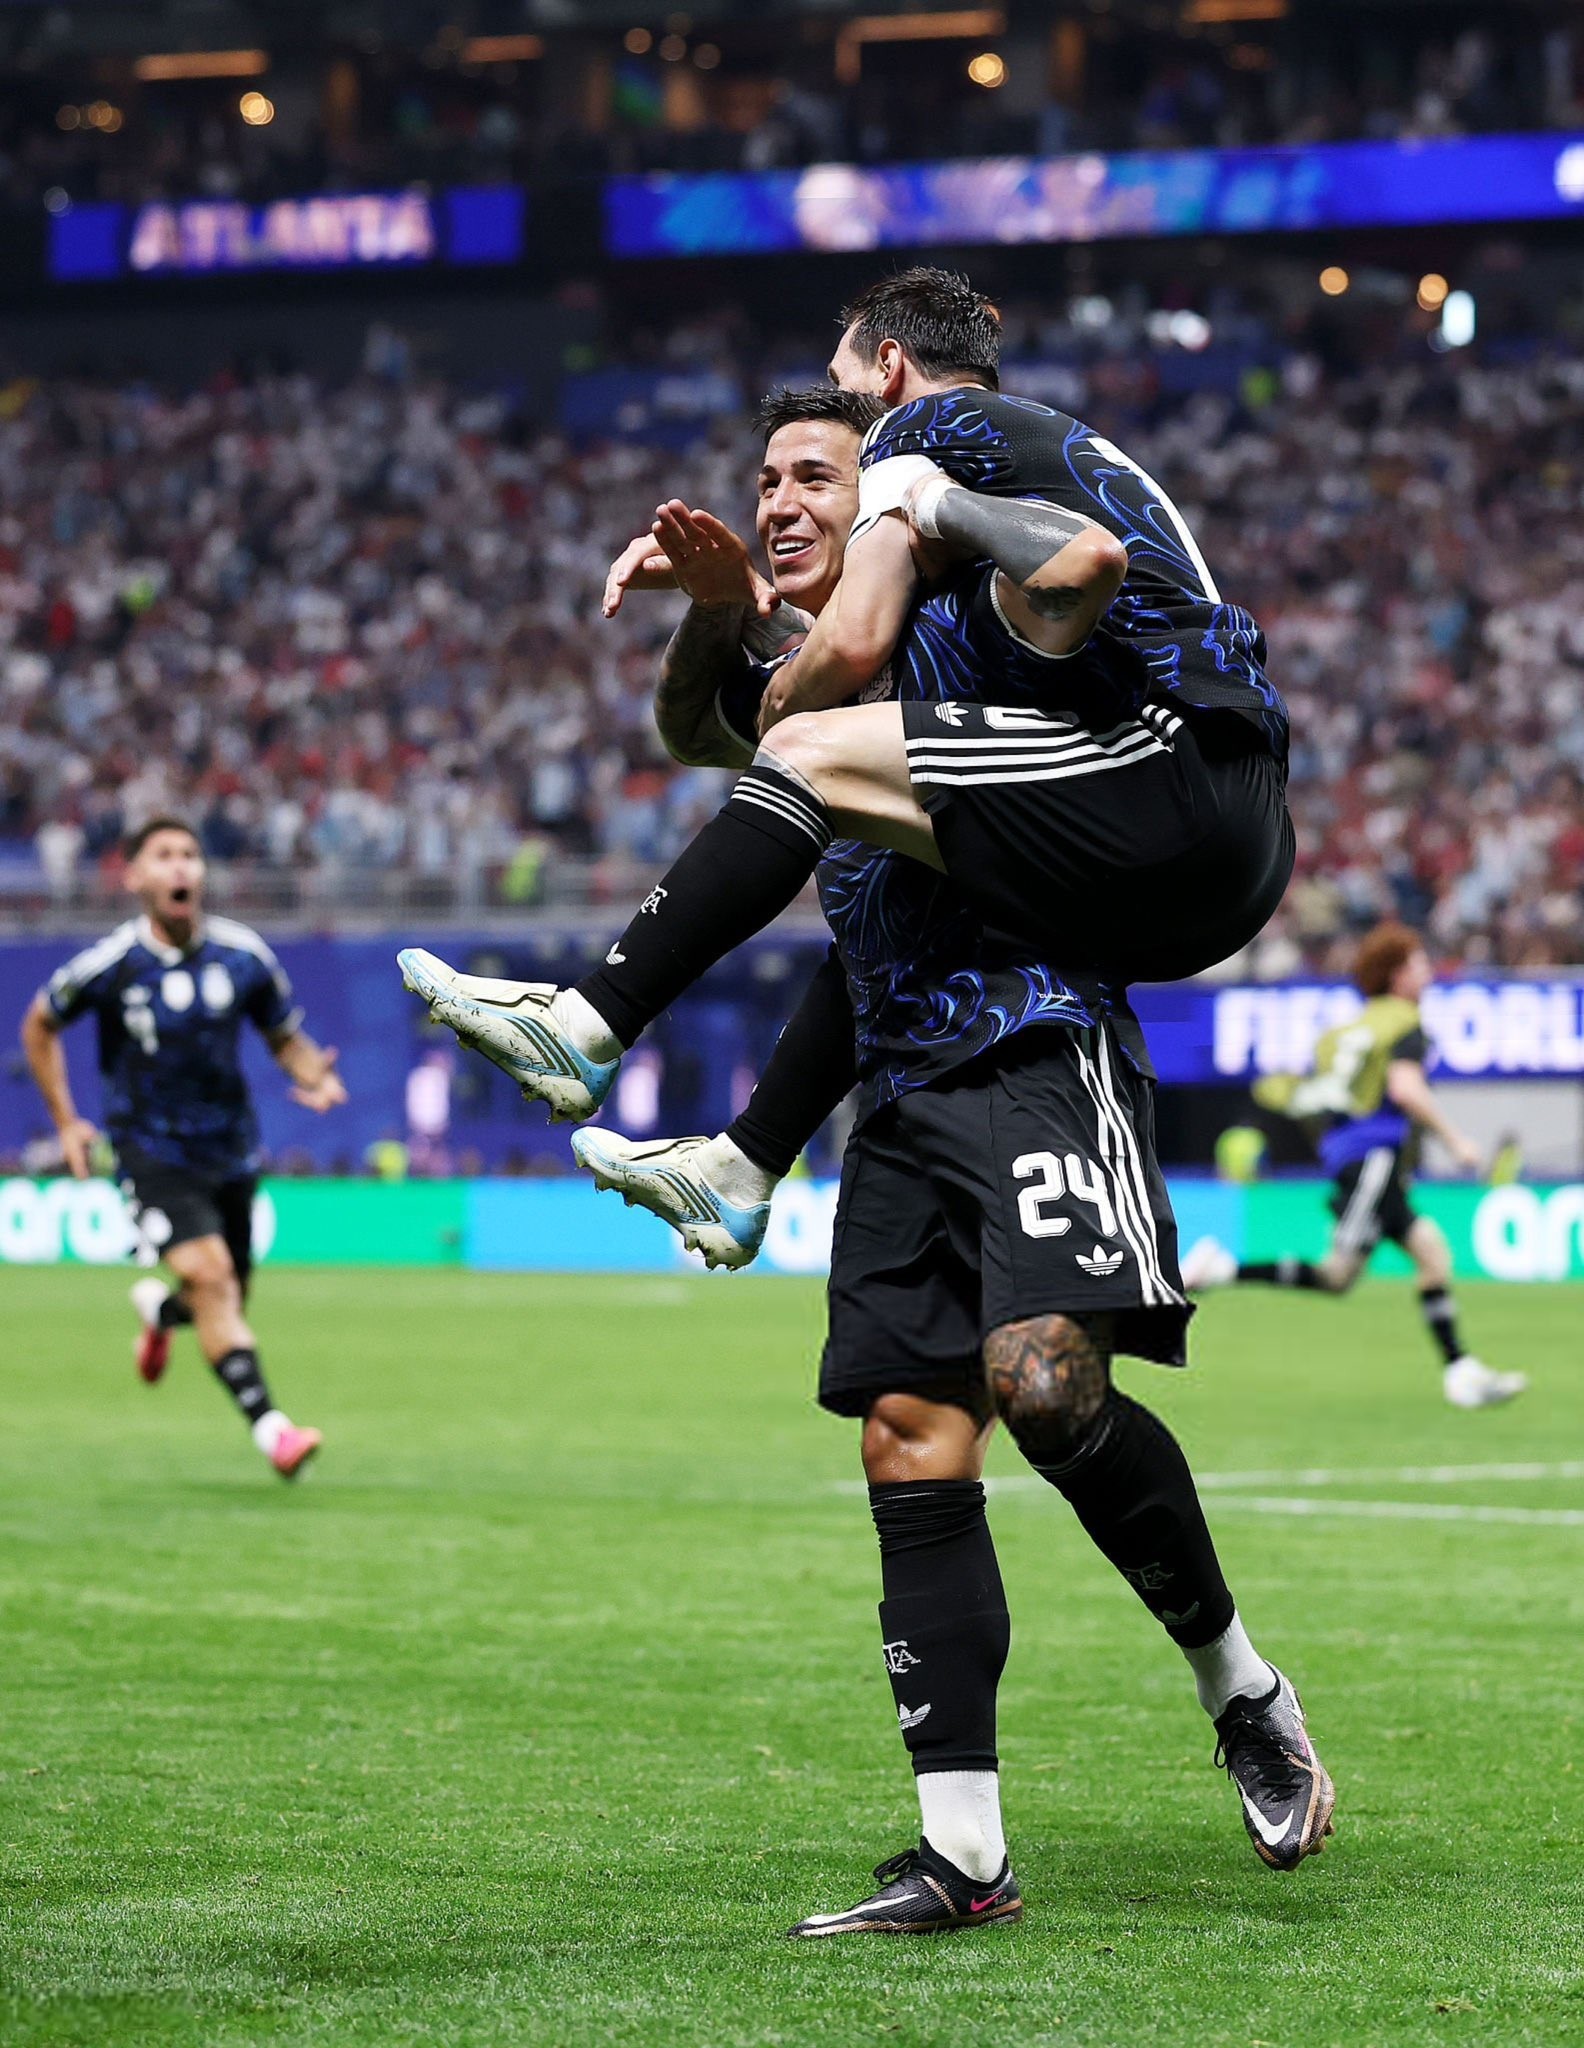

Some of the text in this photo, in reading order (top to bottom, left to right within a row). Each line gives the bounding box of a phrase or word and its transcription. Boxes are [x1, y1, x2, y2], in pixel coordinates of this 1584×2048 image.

[1087, 436, 1222, 604] 1
[1419, 984, 1584, 1073] ORL
[1012, 1151, 1119, 1239] 24
[1471, 1183, 1584, 1283] ar
